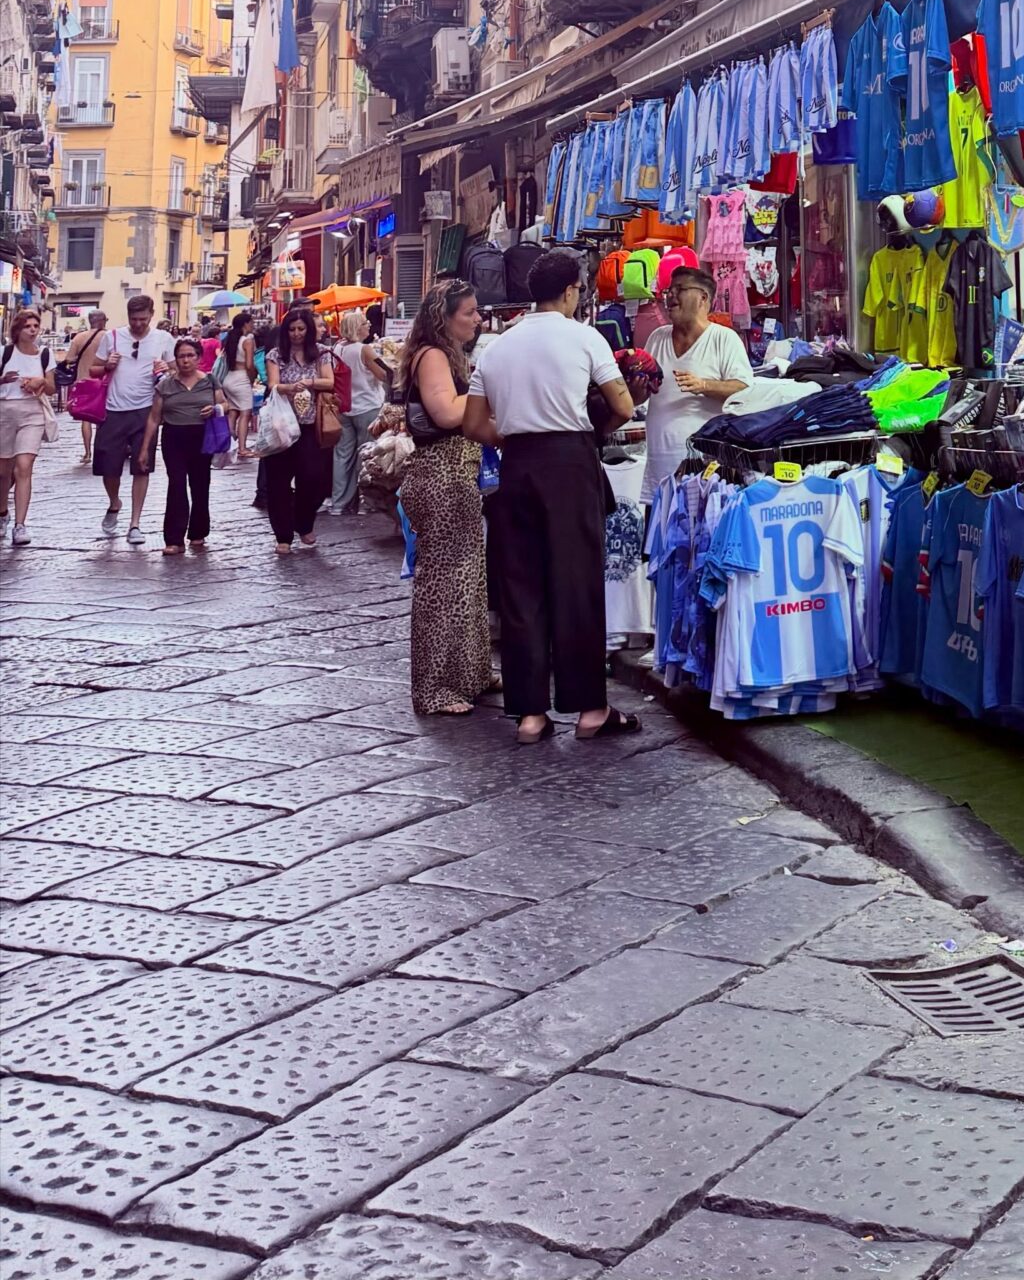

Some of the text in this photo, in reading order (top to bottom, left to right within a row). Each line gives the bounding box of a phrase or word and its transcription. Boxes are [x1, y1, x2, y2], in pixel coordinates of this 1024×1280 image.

[960, 128, 969, 150] 7
[760, 501, 823, 523] MARADONA
[610, 539, 621, 550] 10
[763, 520, 825, 597] 10
[766, 598, 826, 617] KIMBO
